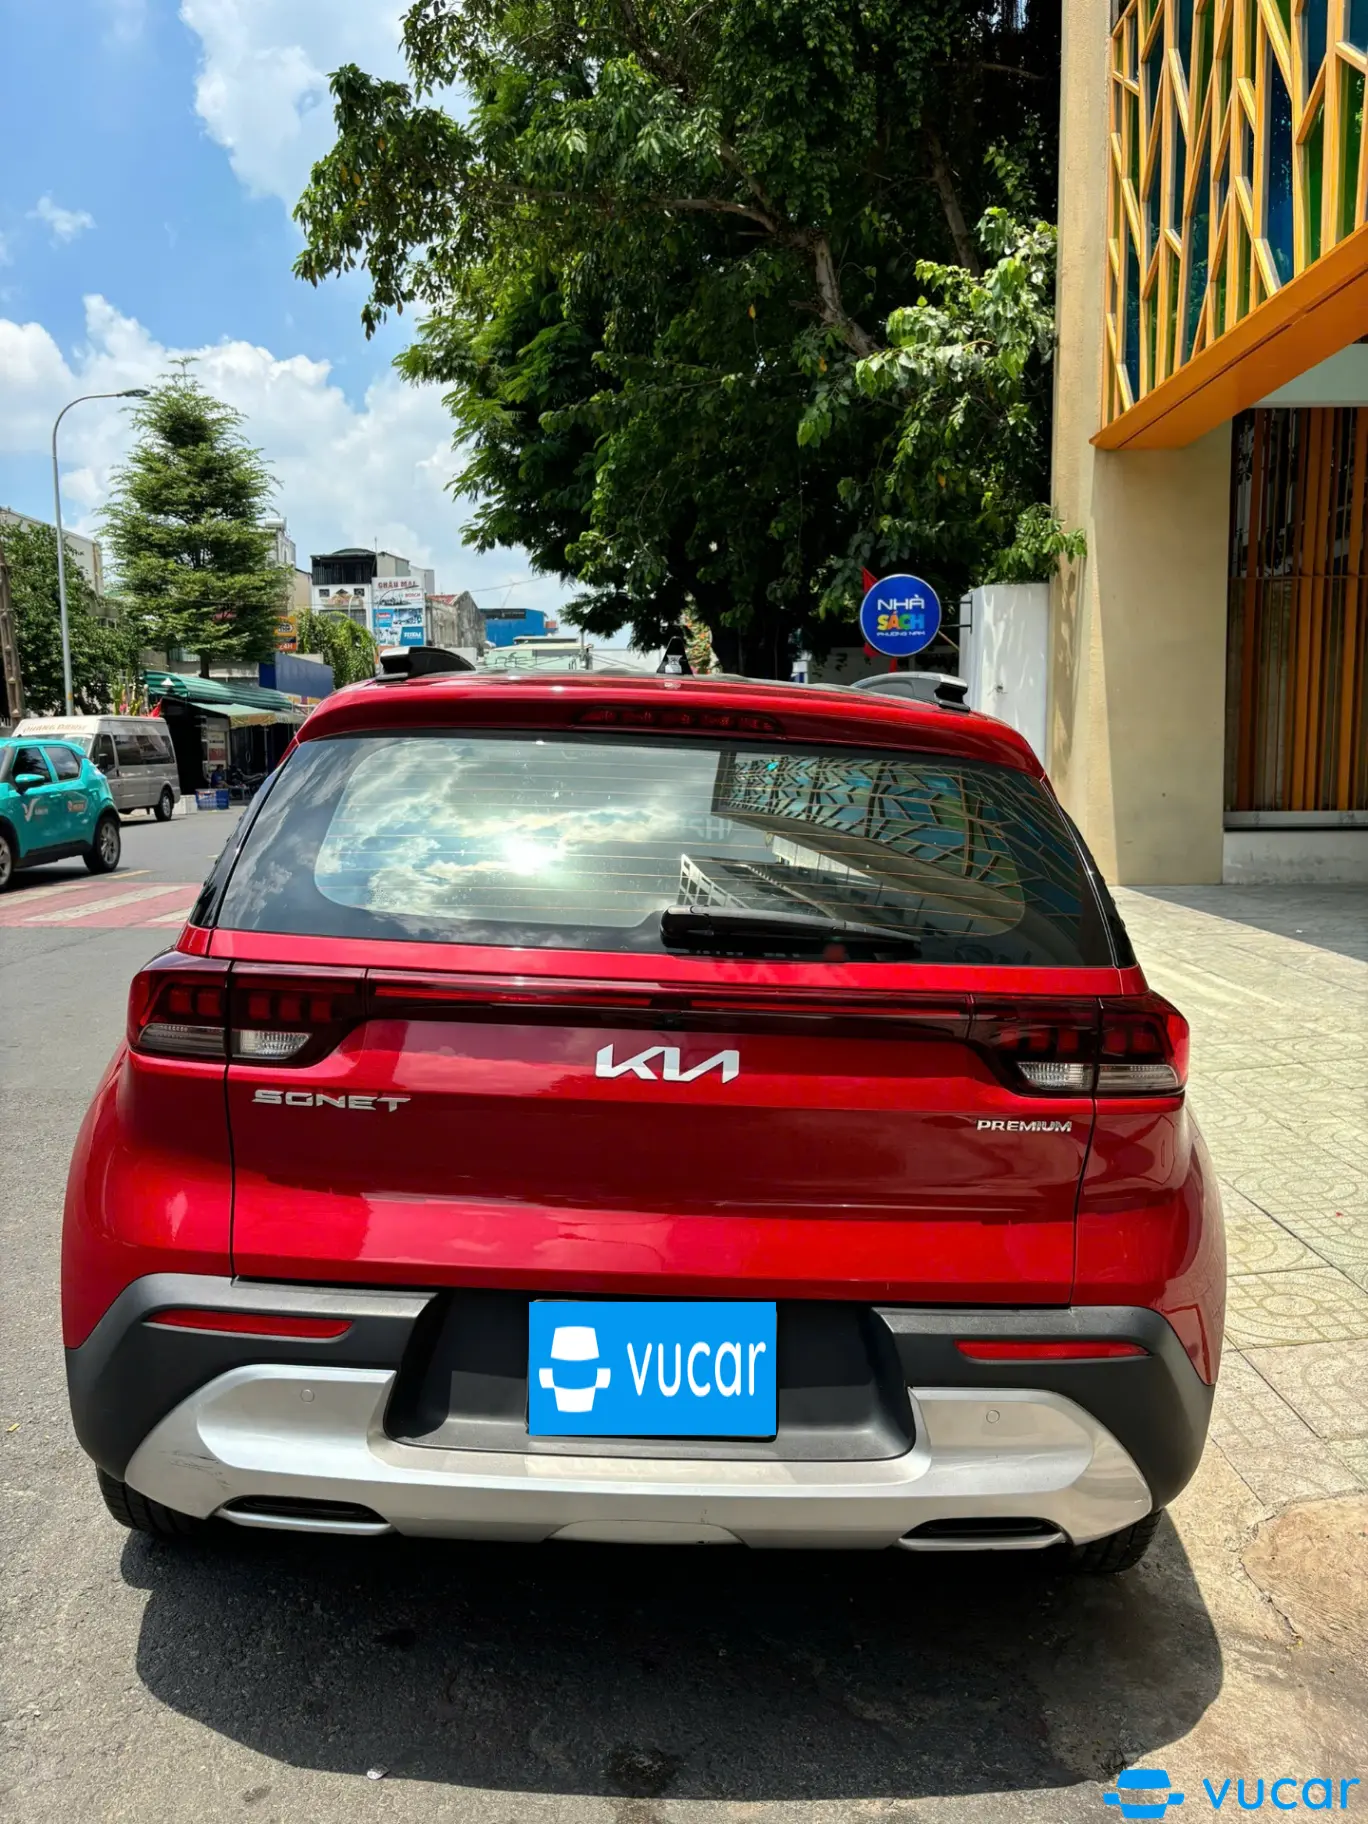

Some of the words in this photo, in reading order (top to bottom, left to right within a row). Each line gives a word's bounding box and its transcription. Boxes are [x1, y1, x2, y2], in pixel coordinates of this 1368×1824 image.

[877, 594, 925, 611] NHÀ
[876, 610, 925, 631] SÁCH
[595, 1044, 740, 1083] KIA
[252, 1088, 412, 1113] SONET
[976, 1119, 1072, 1133] PREMIUM
